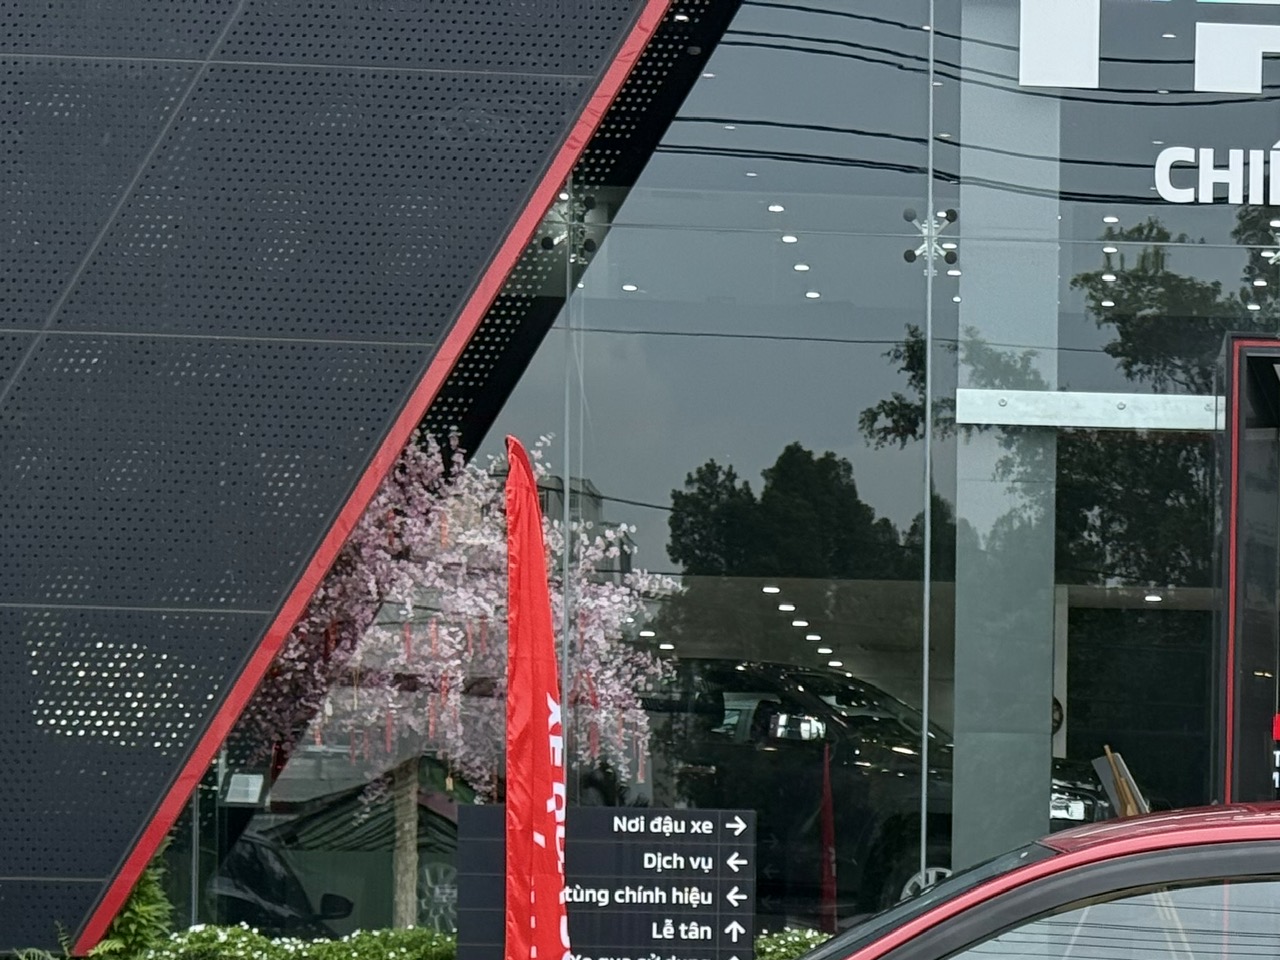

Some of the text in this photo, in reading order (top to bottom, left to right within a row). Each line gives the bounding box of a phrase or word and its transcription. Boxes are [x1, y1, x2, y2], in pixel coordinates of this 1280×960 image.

[613, 816, 713, 837] Nơi đậu xe
[643, 852, 713, 873] Dịch vụ
[564, 884, 713, 908] tùng chính hiệu
[652, 919, 712, 940] Lễ tân
